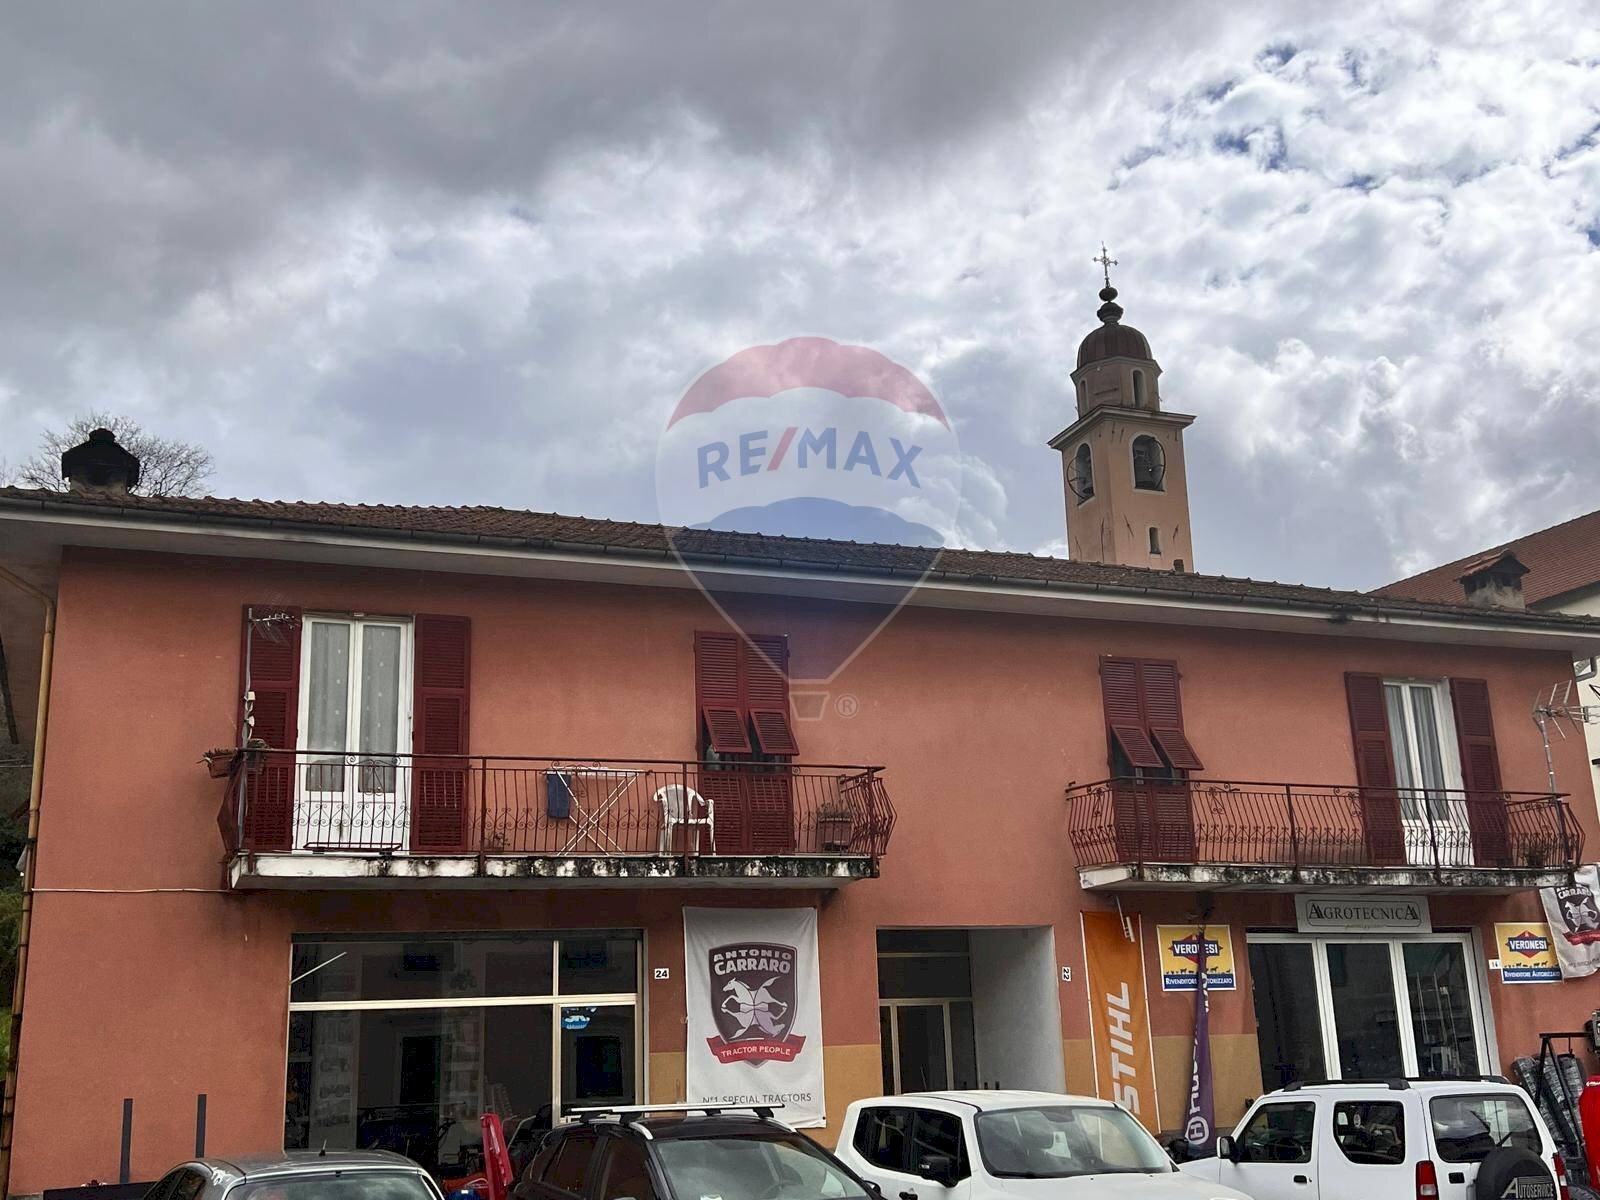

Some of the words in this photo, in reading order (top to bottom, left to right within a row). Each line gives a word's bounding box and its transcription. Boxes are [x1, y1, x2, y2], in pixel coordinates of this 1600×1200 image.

[1173, 943, 1218, 954] VEROESI
[1509, 940, 1547, 950] VERONESI
[713, 949, 792, 962] ANTONIO
[714, 958, 791, 975] CARRARO
[655, 970, 668, 978] 24
[1063, 968, 1070, 980] 22
[721, 1046, 757, 1057] TRACTOR
[759, 1046, 791, 1056] PEOPLE
[1106, 982, 1140, 1115] STIHL
[722, 1095, 760, 1104] SPECIAL
[763, 1093, 812, 1103] TRACTORS
[1500, 1177, 1554, 1199] AUTOSERVICE
